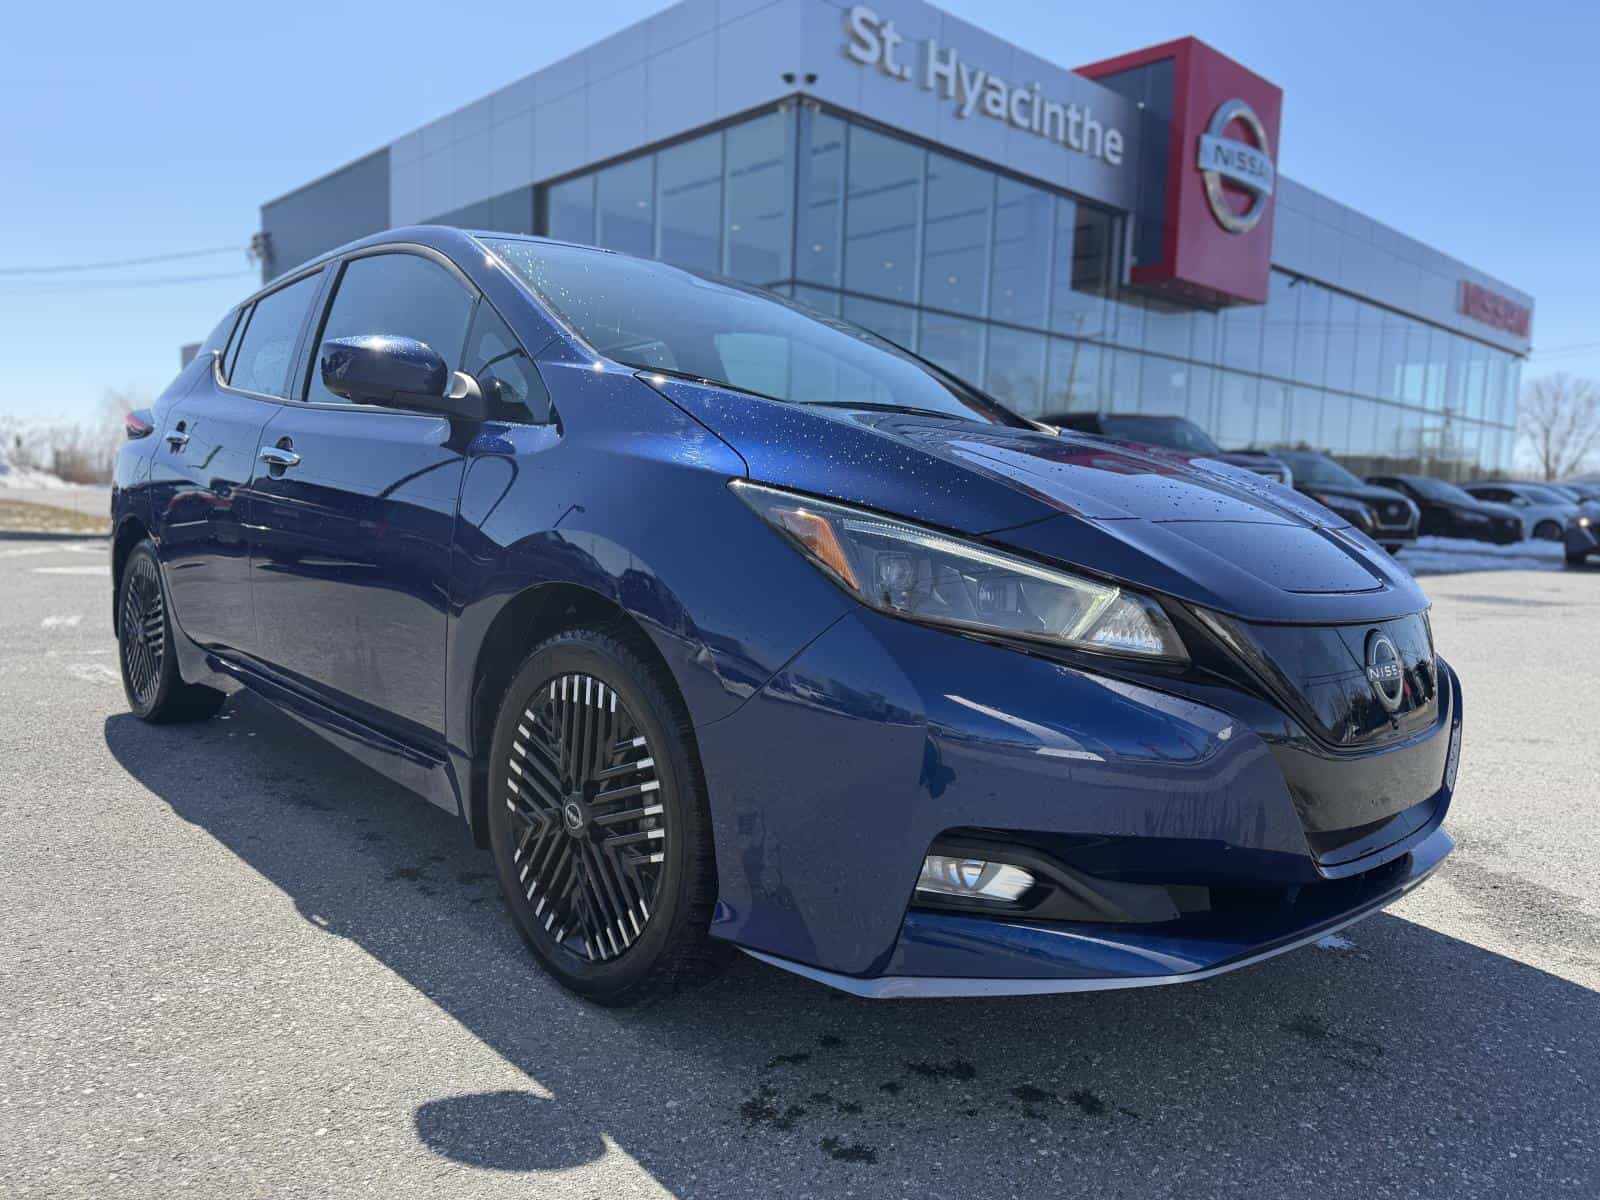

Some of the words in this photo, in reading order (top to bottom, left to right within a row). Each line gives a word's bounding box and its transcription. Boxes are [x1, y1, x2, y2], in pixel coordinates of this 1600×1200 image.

[848, 5, 912, 80] St.
[926, 37, 1124, 166] Hyacinthe
[1213, 144, 1268, 179] NISSA
[1369, 664, 1401, 679] NISS
